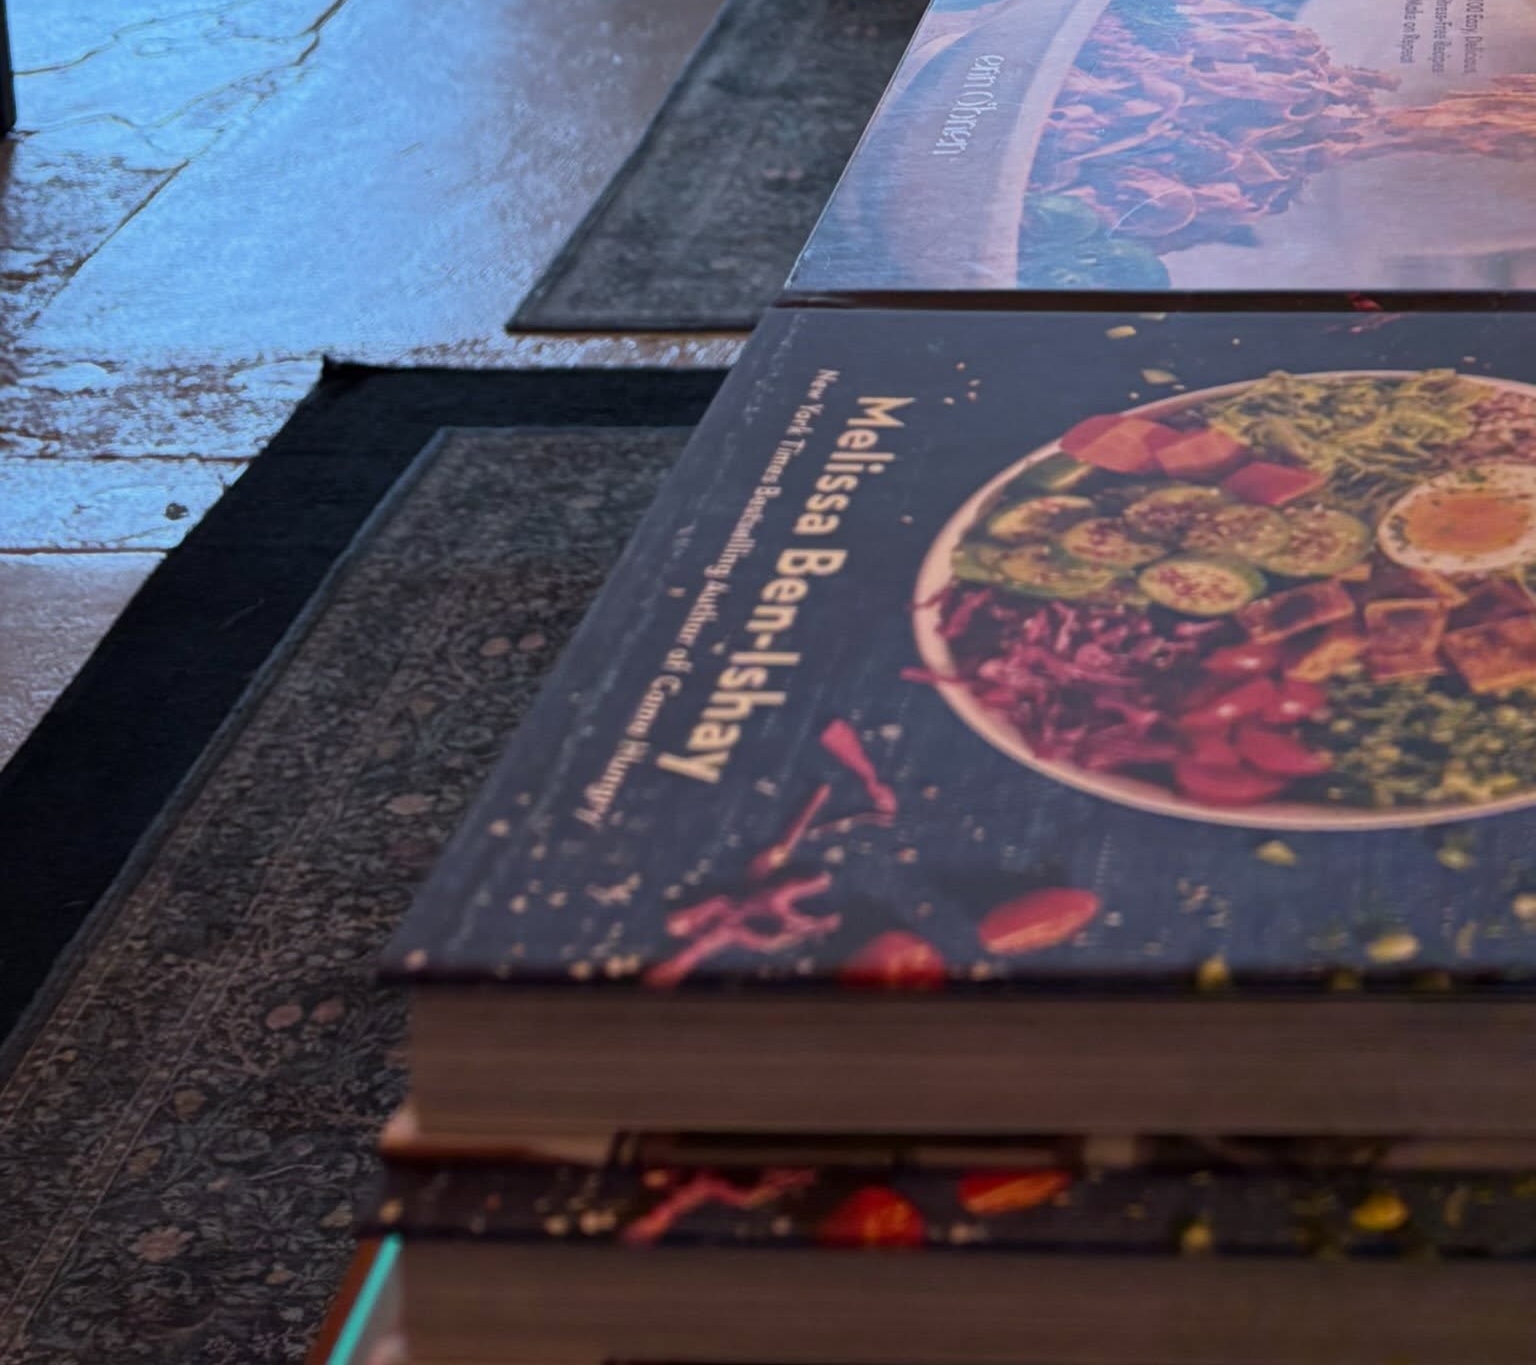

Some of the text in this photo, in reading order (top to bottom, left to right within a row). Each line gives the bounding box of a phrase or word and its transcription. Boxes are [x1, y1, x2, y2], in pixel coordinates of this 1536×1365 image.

[807, 368, 840, 400] New
[786, 403, 826, 437] York
[760, 438, 806, 485] Times
[655, 395, 917, 784] Melissa Ben-Ishay
[663, 646, 696, 673] of
